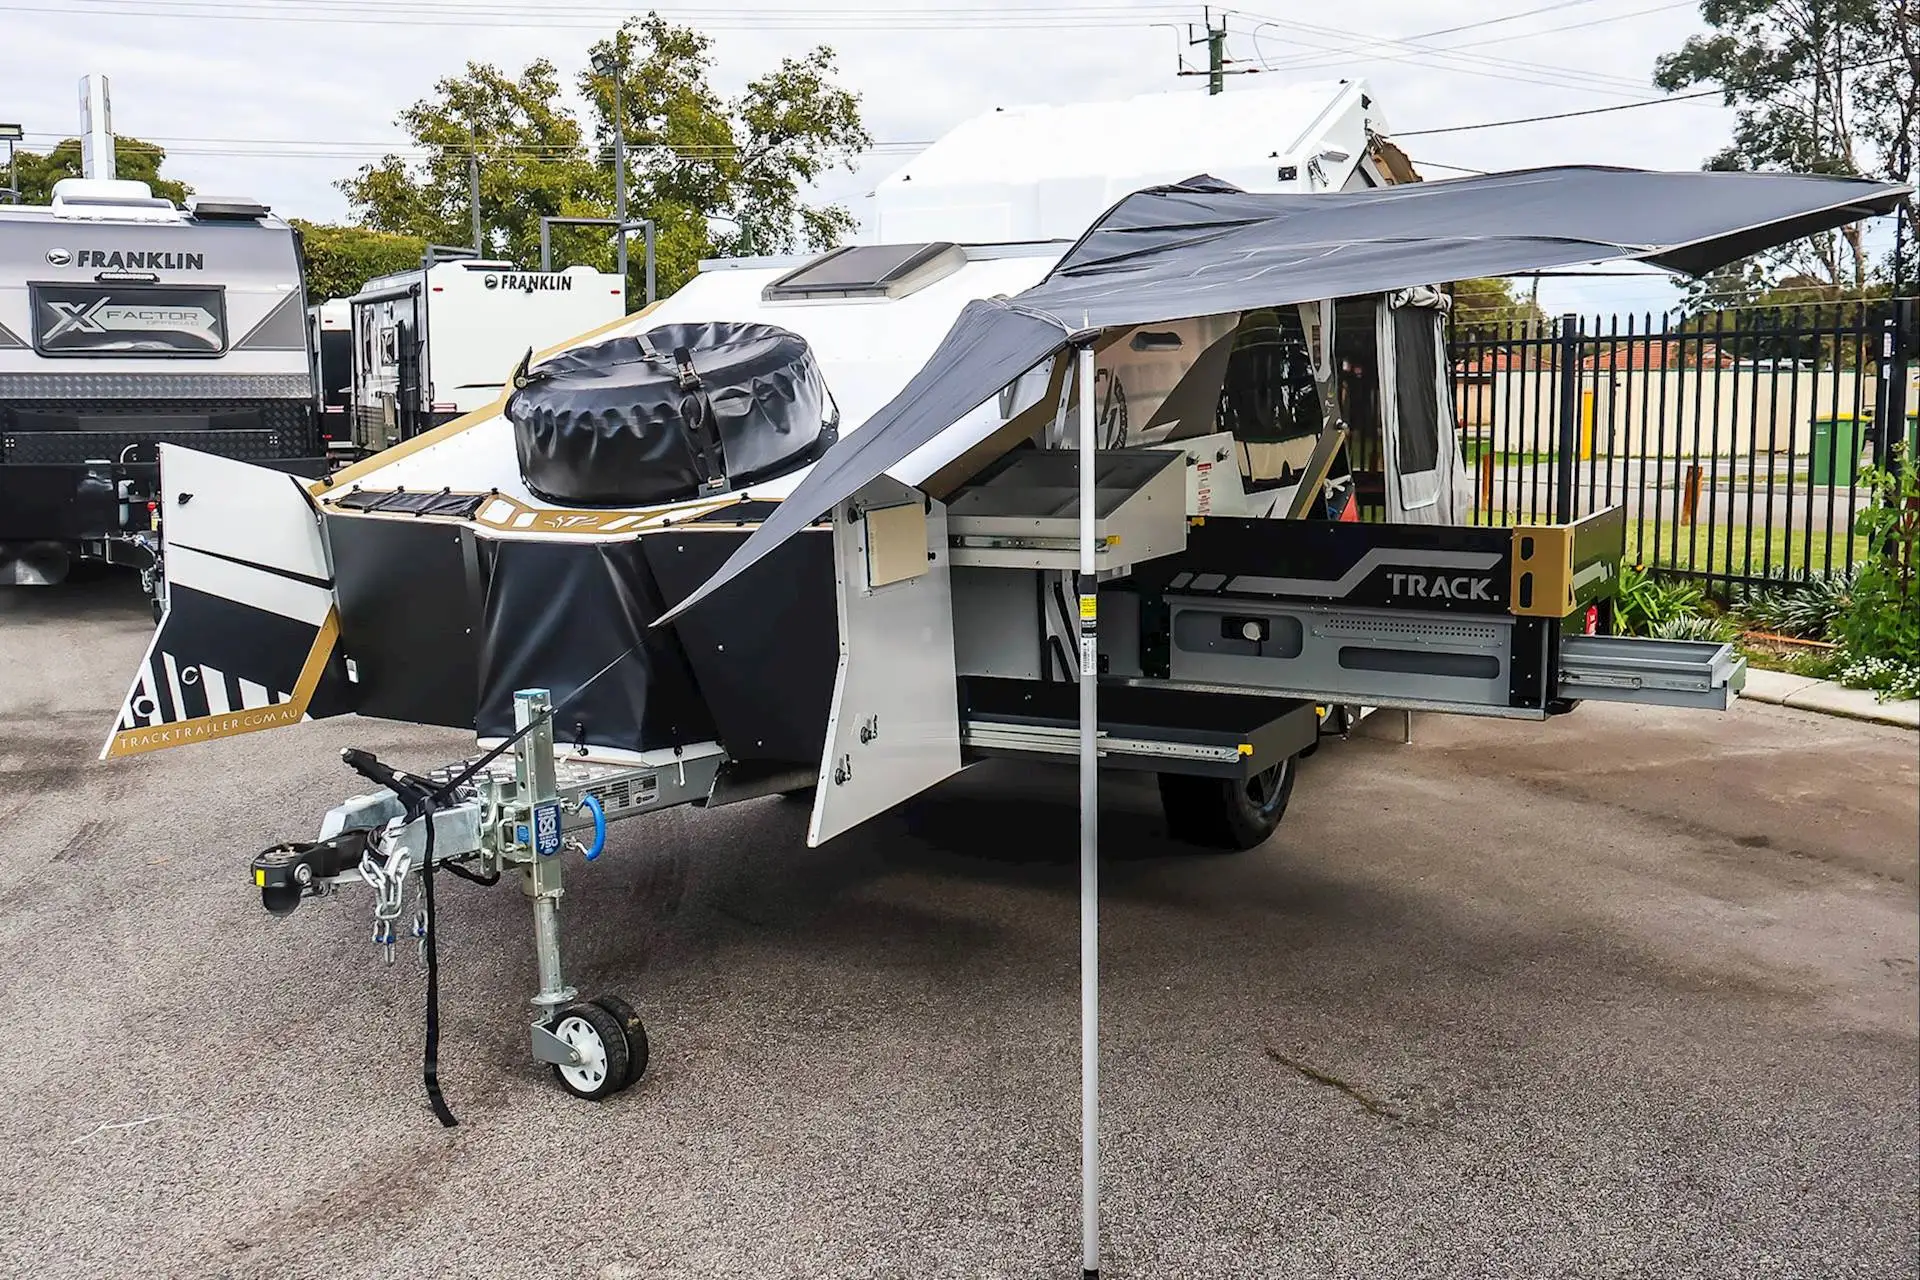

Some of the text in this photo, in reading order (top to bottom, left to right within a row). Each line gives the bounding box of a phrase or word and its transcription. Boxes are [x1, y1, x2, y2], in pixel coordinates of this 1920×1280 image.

[77, 250, 204, 270] FRANKLIN
[501, 274, 572, 290] FRANKLIN
[106, 311, 198, 320] FACTOR
[539, 838, 558, 849] 750
